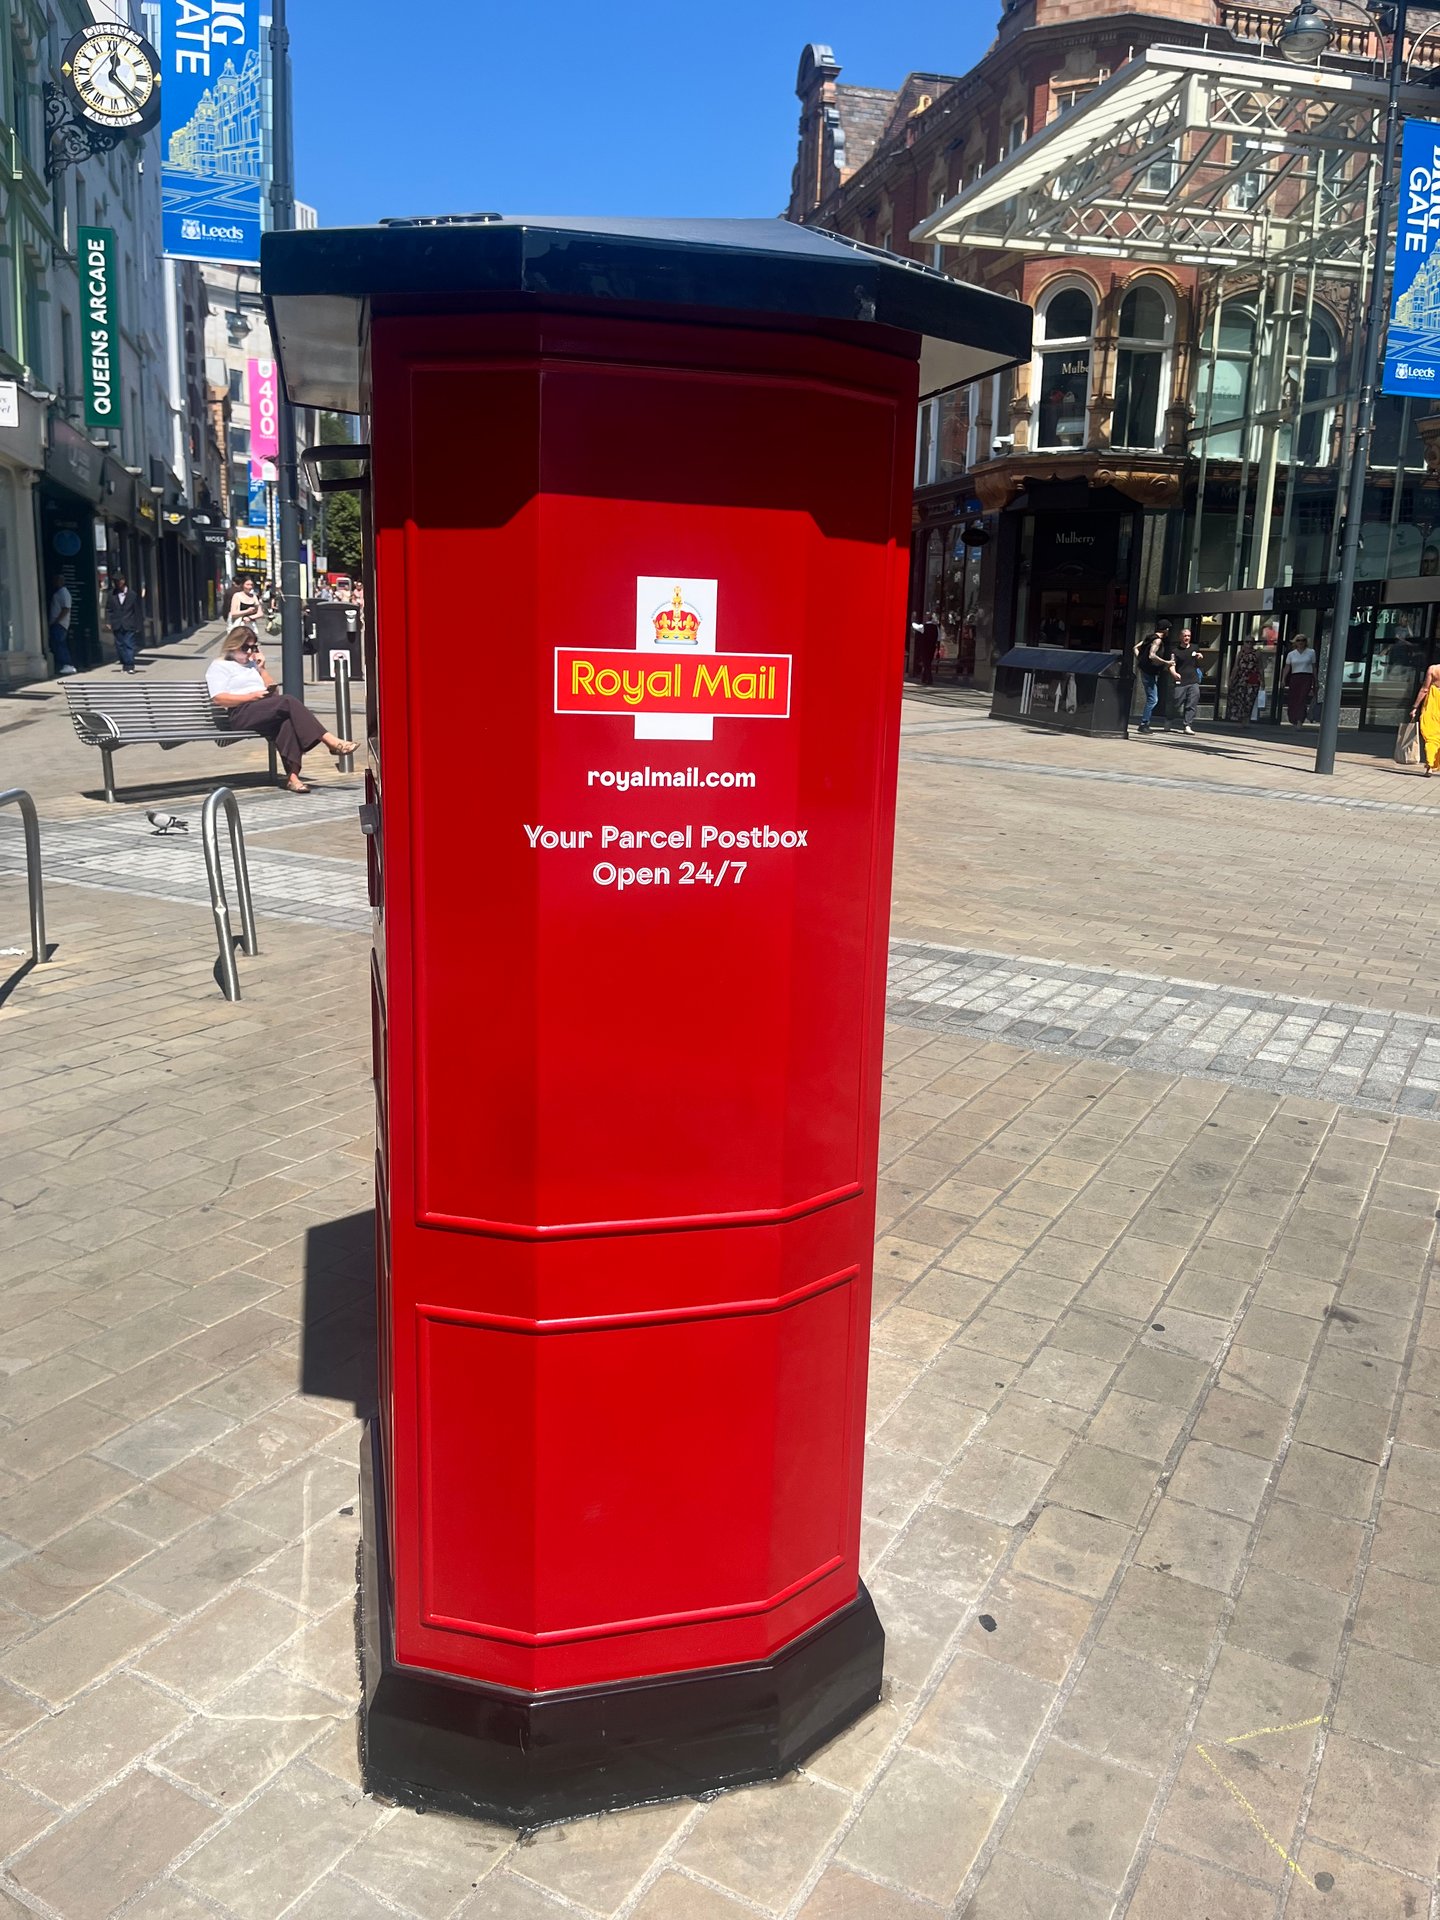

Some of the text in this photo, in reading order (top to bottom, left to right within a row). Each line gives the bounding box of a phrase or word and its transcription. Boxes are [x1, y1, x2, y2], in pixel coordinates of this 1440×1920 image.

[89, 111, 137, 126] ARCADE
[1405, 166, 1431, 253] GATE
[202, 224, 243, 239] Leeds
[88, 239, 112, 415] QUEENS ARCADE
[1408, 366, 1435, 378] Leeds
[259, 380, 275, 435] 400
[1056, 531, 1096, 545] Mulberry
[571, 660, 776, 705] Royal Mail
[587, 767, 756, 792] royalmail.com
[523, 824, 808, 849] Your Parcel Postbox
[592, 860, 748, 891] Open 24/7
